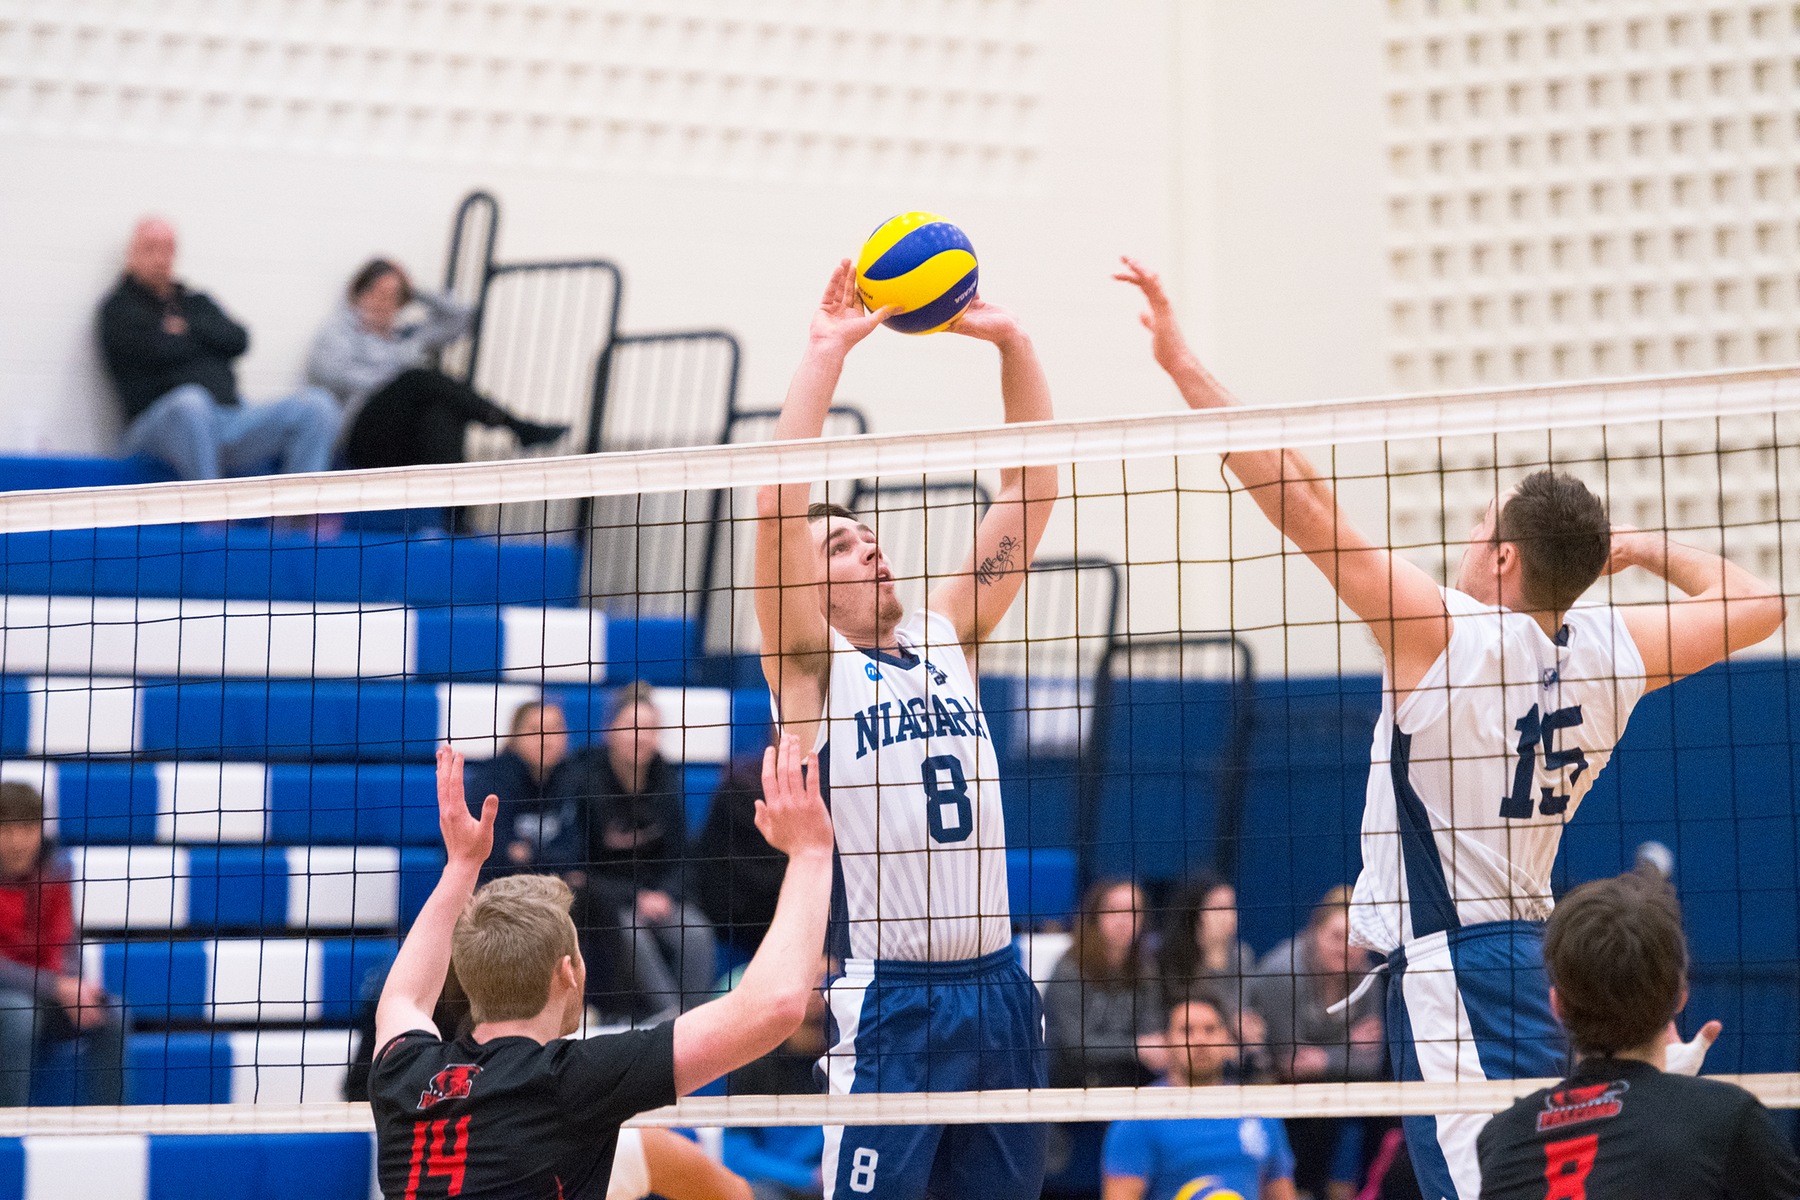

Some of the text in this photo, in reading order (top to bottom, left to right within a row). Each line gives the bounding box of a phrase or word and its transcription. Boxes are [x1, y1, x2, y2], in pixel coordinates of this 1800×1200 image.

[920, 754, 973, 844] 8
[1499, 703, 1588, 818] 15
[404, 1115, 472, 1200] 14
[849, 1147, 879, 1194] 8
